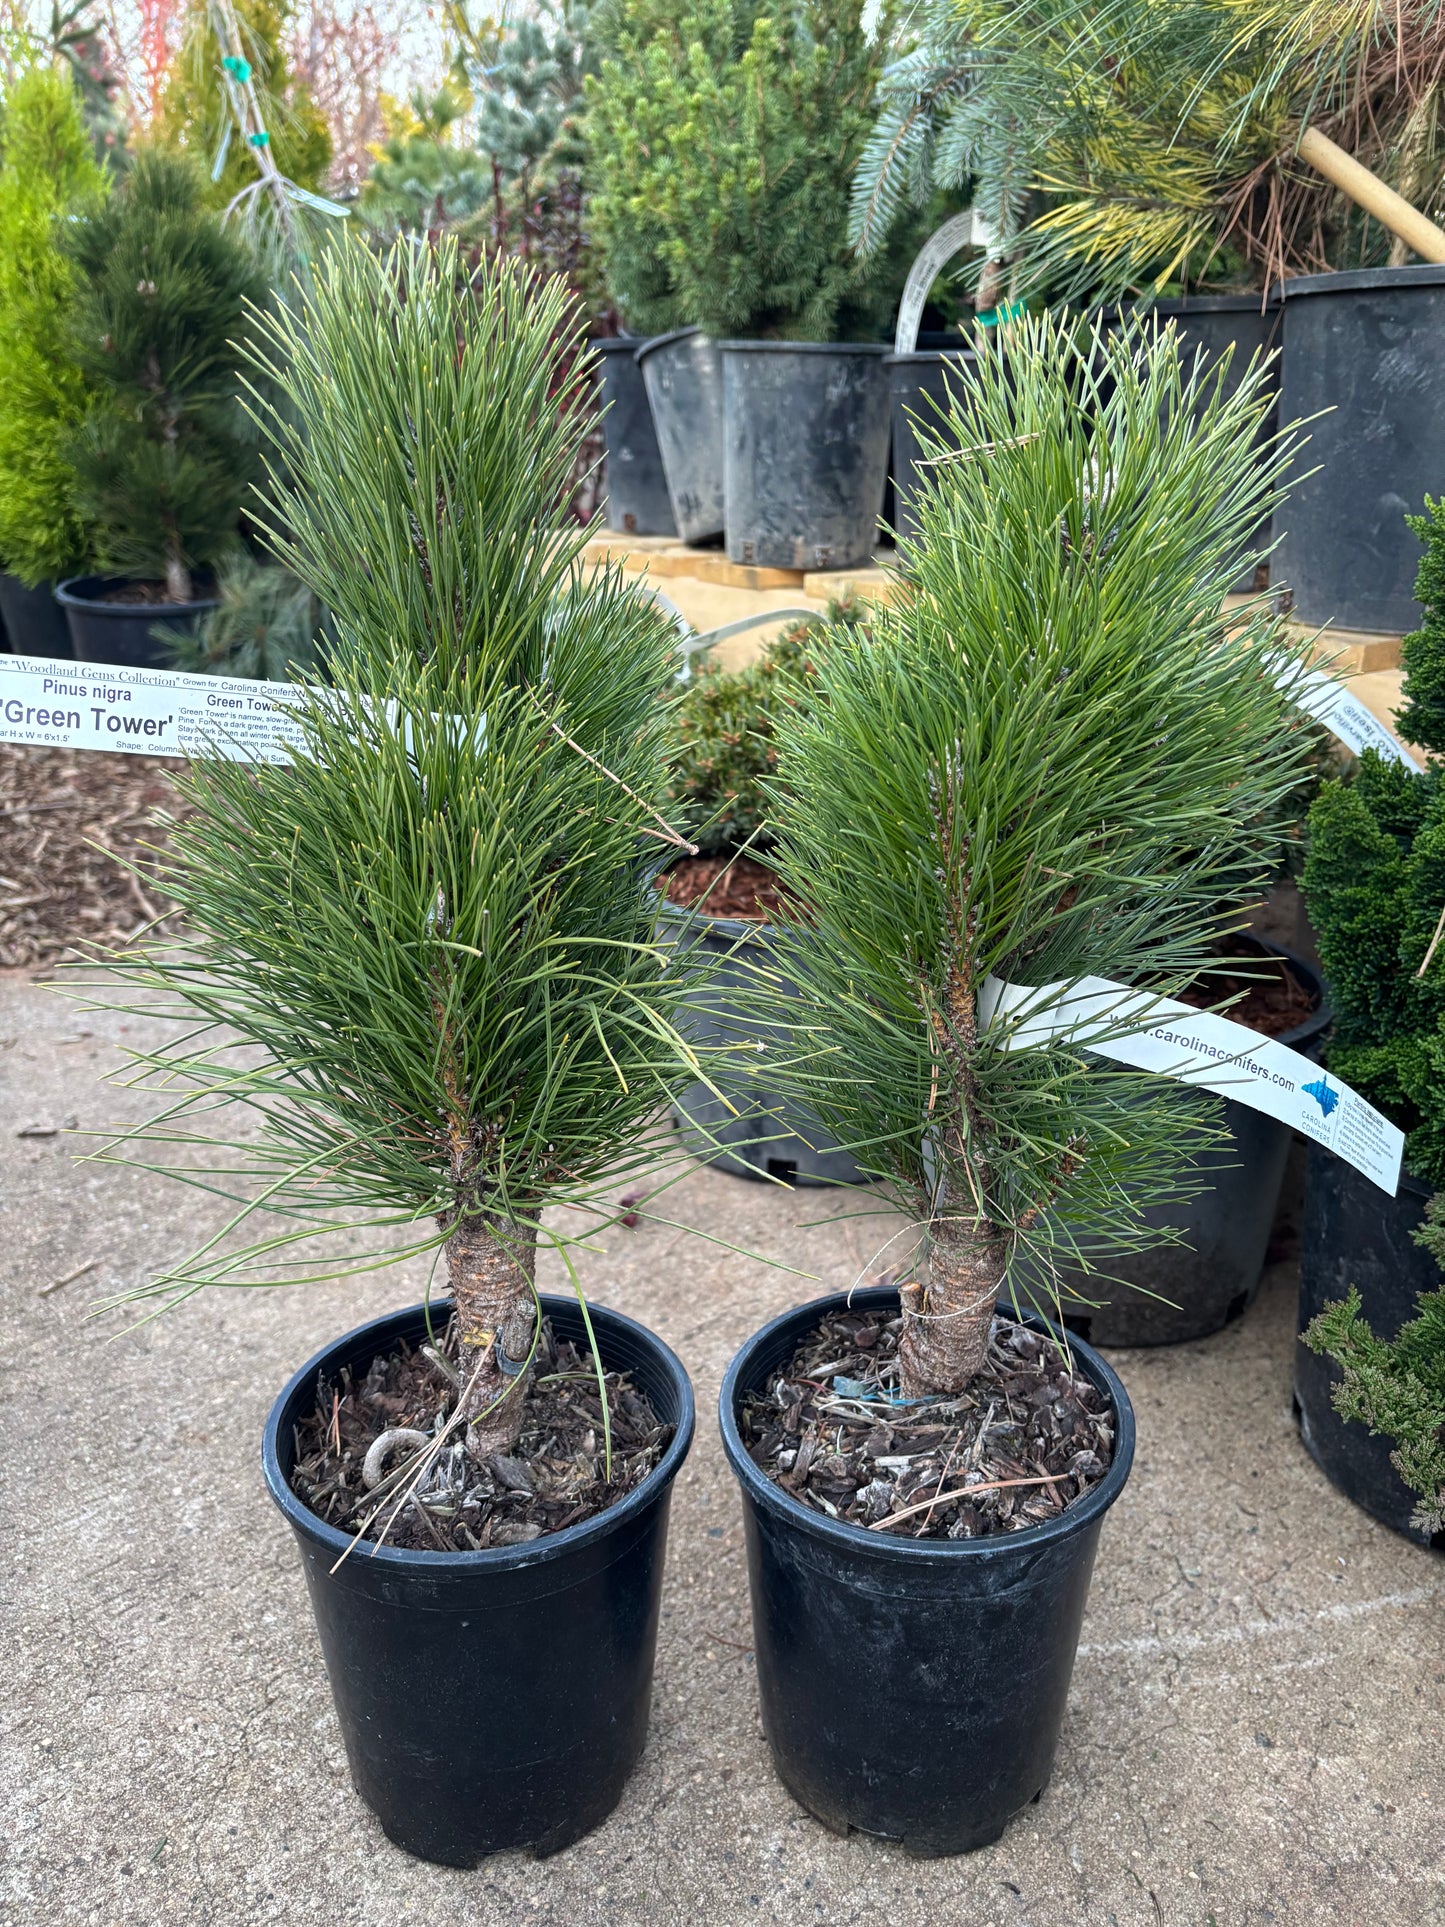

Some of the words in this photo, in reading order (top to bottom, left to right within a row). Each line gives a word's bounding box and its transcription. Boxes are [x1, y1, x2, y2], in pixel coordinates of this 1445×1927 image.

[43, 679, 87, 697] Pinus
[92, 684, 132, 703] nigra
[81, 667, 115, 680] Gems
[118, 671, 180, 687] Collection"
[182, 678, 207, 687] Grown
[221, 681, 258, 693] Carolina
[260, 685, 296, 697] Conifers
[206, 694, 243, 709] Green
[0, 699, 81, 729] 'Green
[90, 707, 173, 737] Tower'
[230, 711, 236, 719] is
[238, 713, 264, 723] narrow,
[230, 720, 246, 729] dark
[247, 723, 270, 732] green,
[271, 725, 295, 734] dense,
[9, 730, 17, 738] H
[25, 731, 35, 739] W
[286, 735, 304, 743] large
[116, 740, 144, 750] Shape:
[270, 754, 286, 762] Sun
[1301, 1110, 1332, 1133] CAROLINA
[1301, 1121, 1330, 1144] CONIFERS
